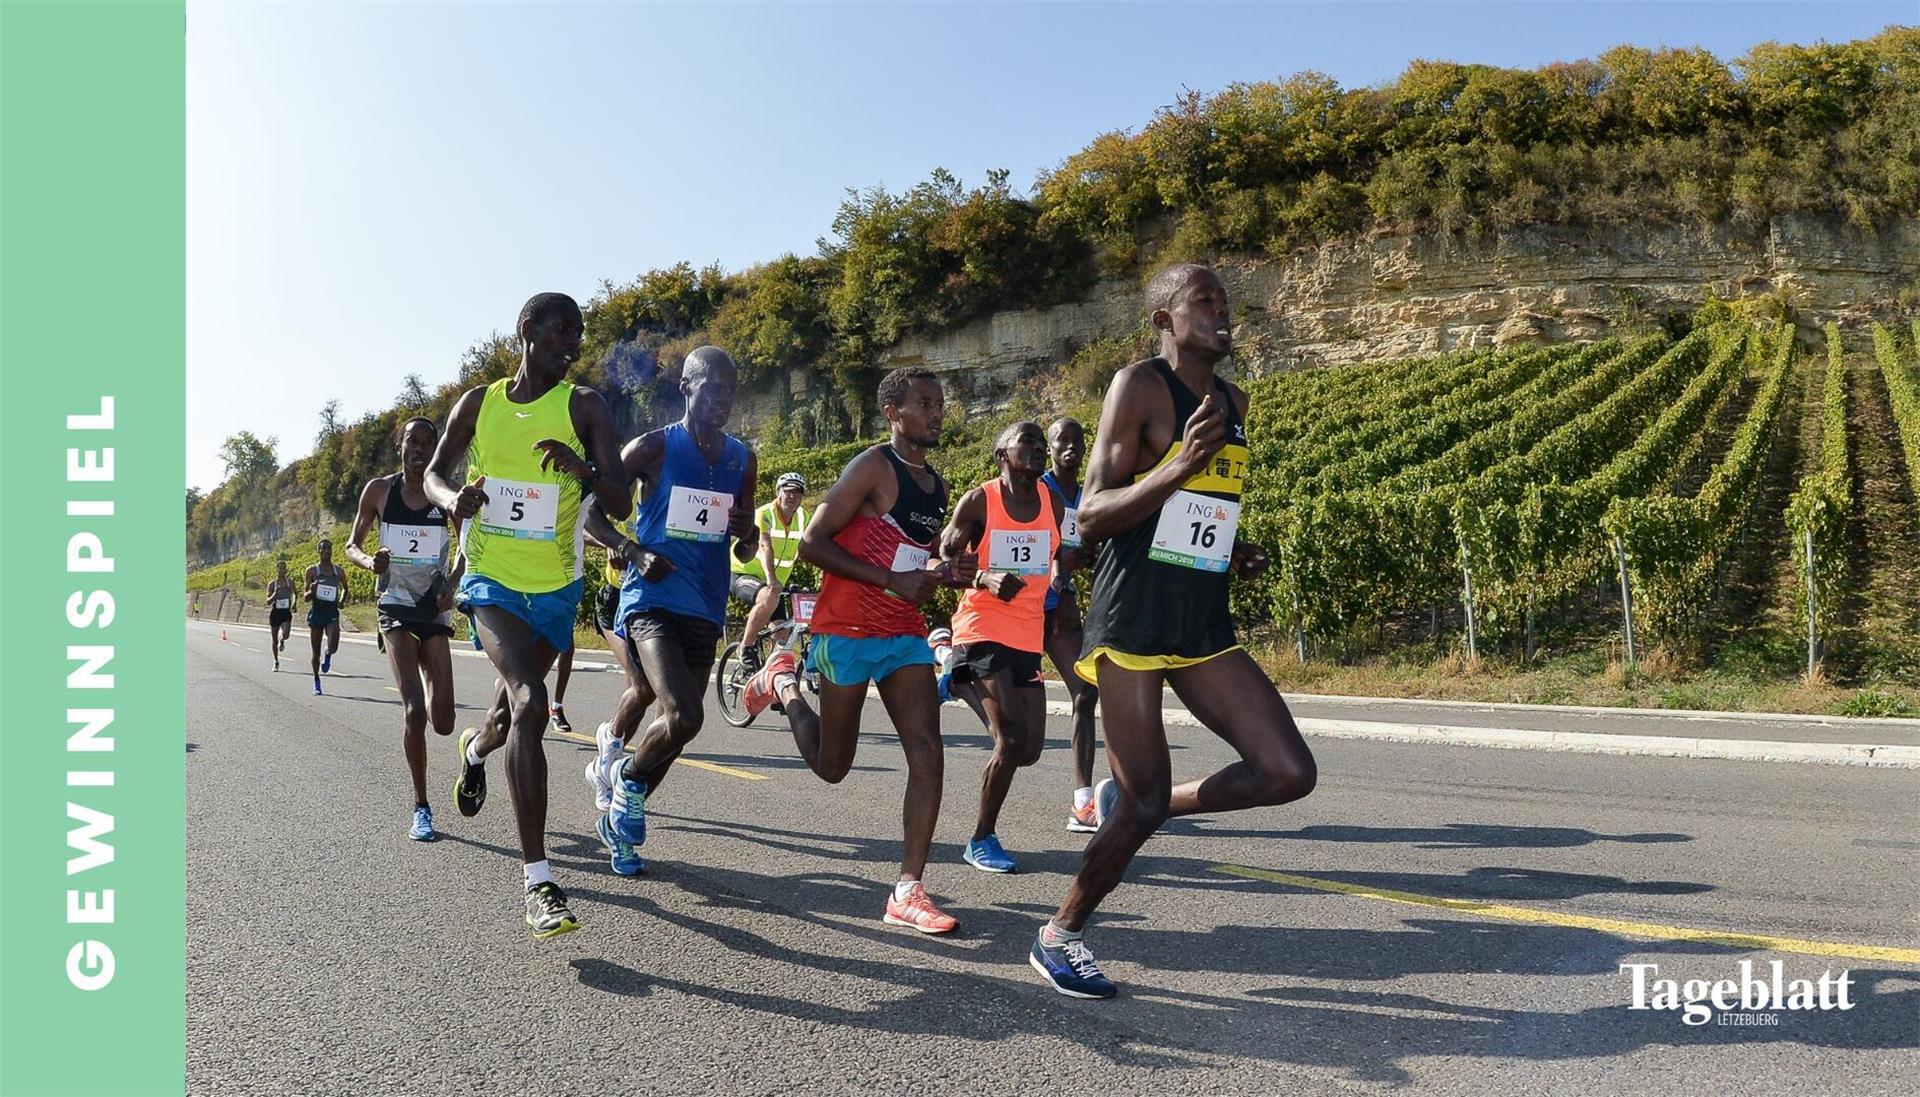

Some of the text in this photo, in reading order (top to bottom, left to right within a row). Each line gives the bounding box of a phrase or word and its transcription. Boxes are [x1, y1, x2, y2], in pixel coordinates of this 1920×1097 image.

[500, 486, 524, 498] ING
[687, 494, 709, 506] ING
[509, 501, 525, 522] 5
[1186, 502, 1213, 518] ING
[695, 508, 709, 527] 4
[401, 529, 418, 537] ING
[1069, 522, 1076, 536] 3
[1189, 521, 1217, 549] 16
[408, 539, 419, 553] 2
[1006, 535, 1025, 544] ING
[909, 552, 923, 565] ING
[1011, 546, 1031, 563] 13
[1151, 549, 1178, 562] REMICH
[1178, 557, 1194, 566] 2018
